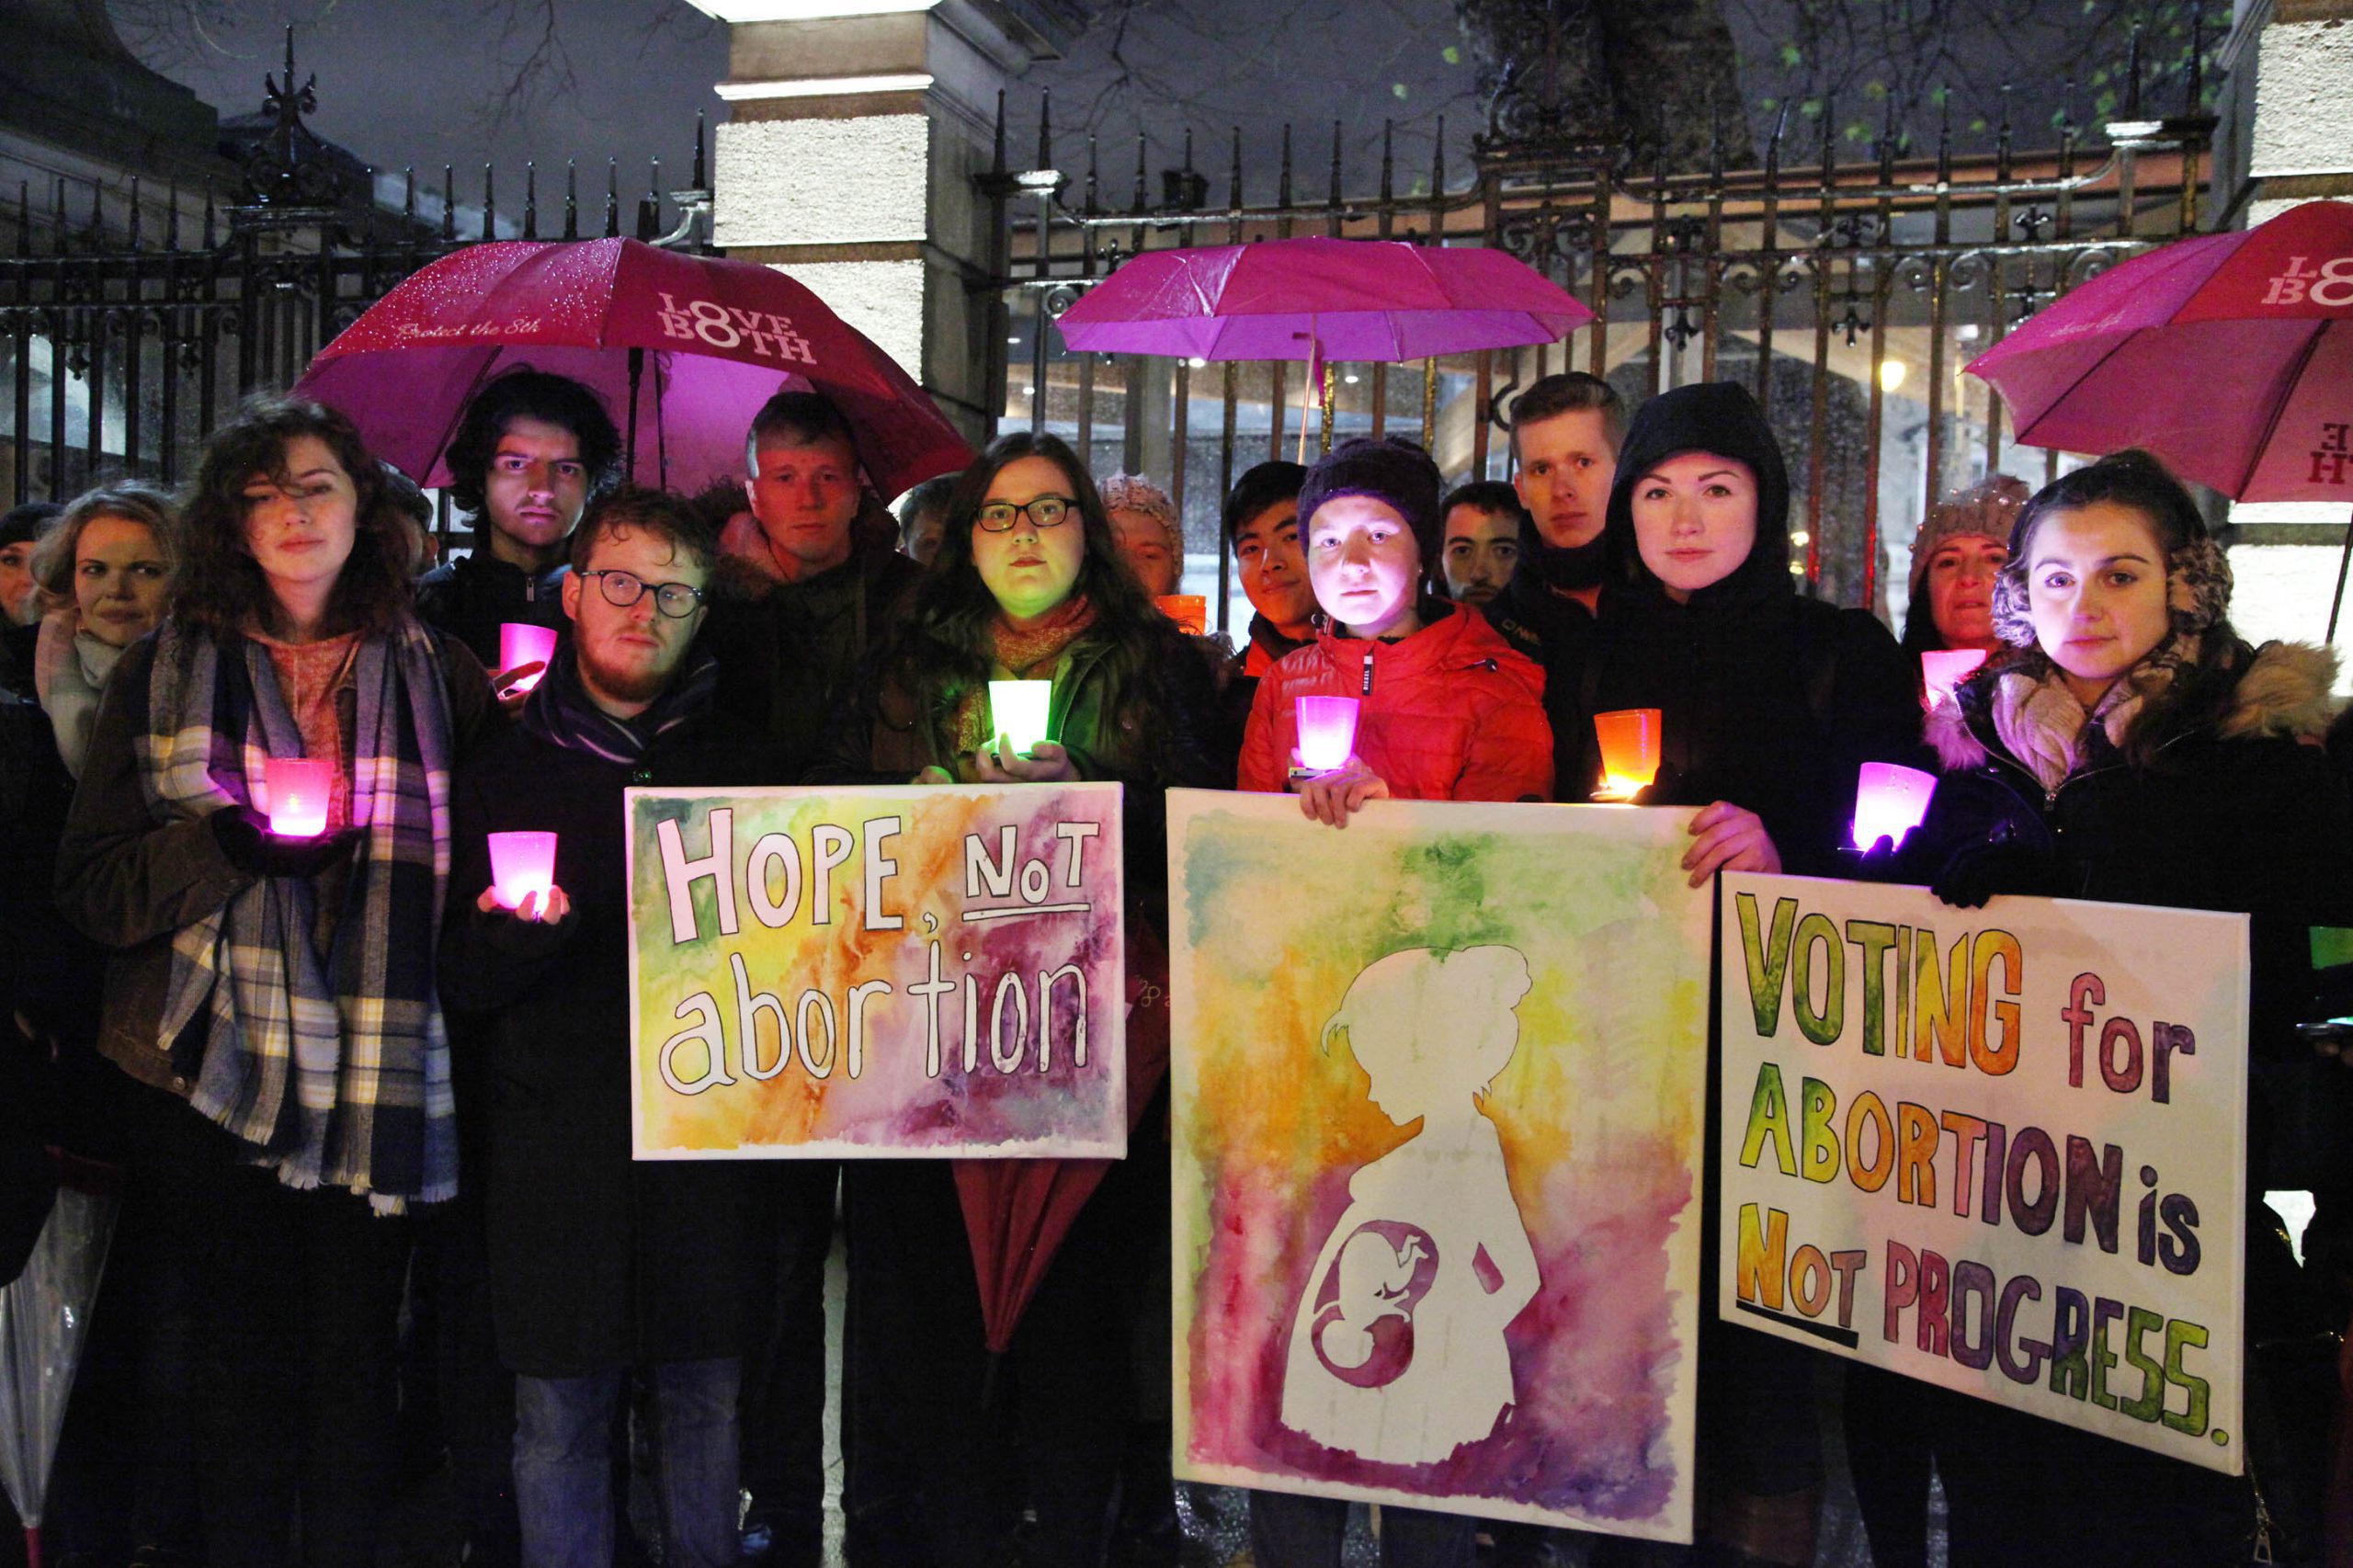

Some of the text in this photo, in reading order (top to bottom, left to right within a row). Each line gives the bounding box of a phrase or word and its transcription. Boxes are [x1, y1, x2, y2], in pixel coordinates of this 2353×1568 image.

[396, 318, 540, 338] Protect the 8th
[656, 808, 938, 945] HOPE,
[659, 940, 1086, 1096] abortion
[1735, 892, 2196, 1104] VOTING for
[1739, 1062, 2200, 1276] ABORTION is
[1737, 1203, 2230, 1448] NOT PROGRESS.
